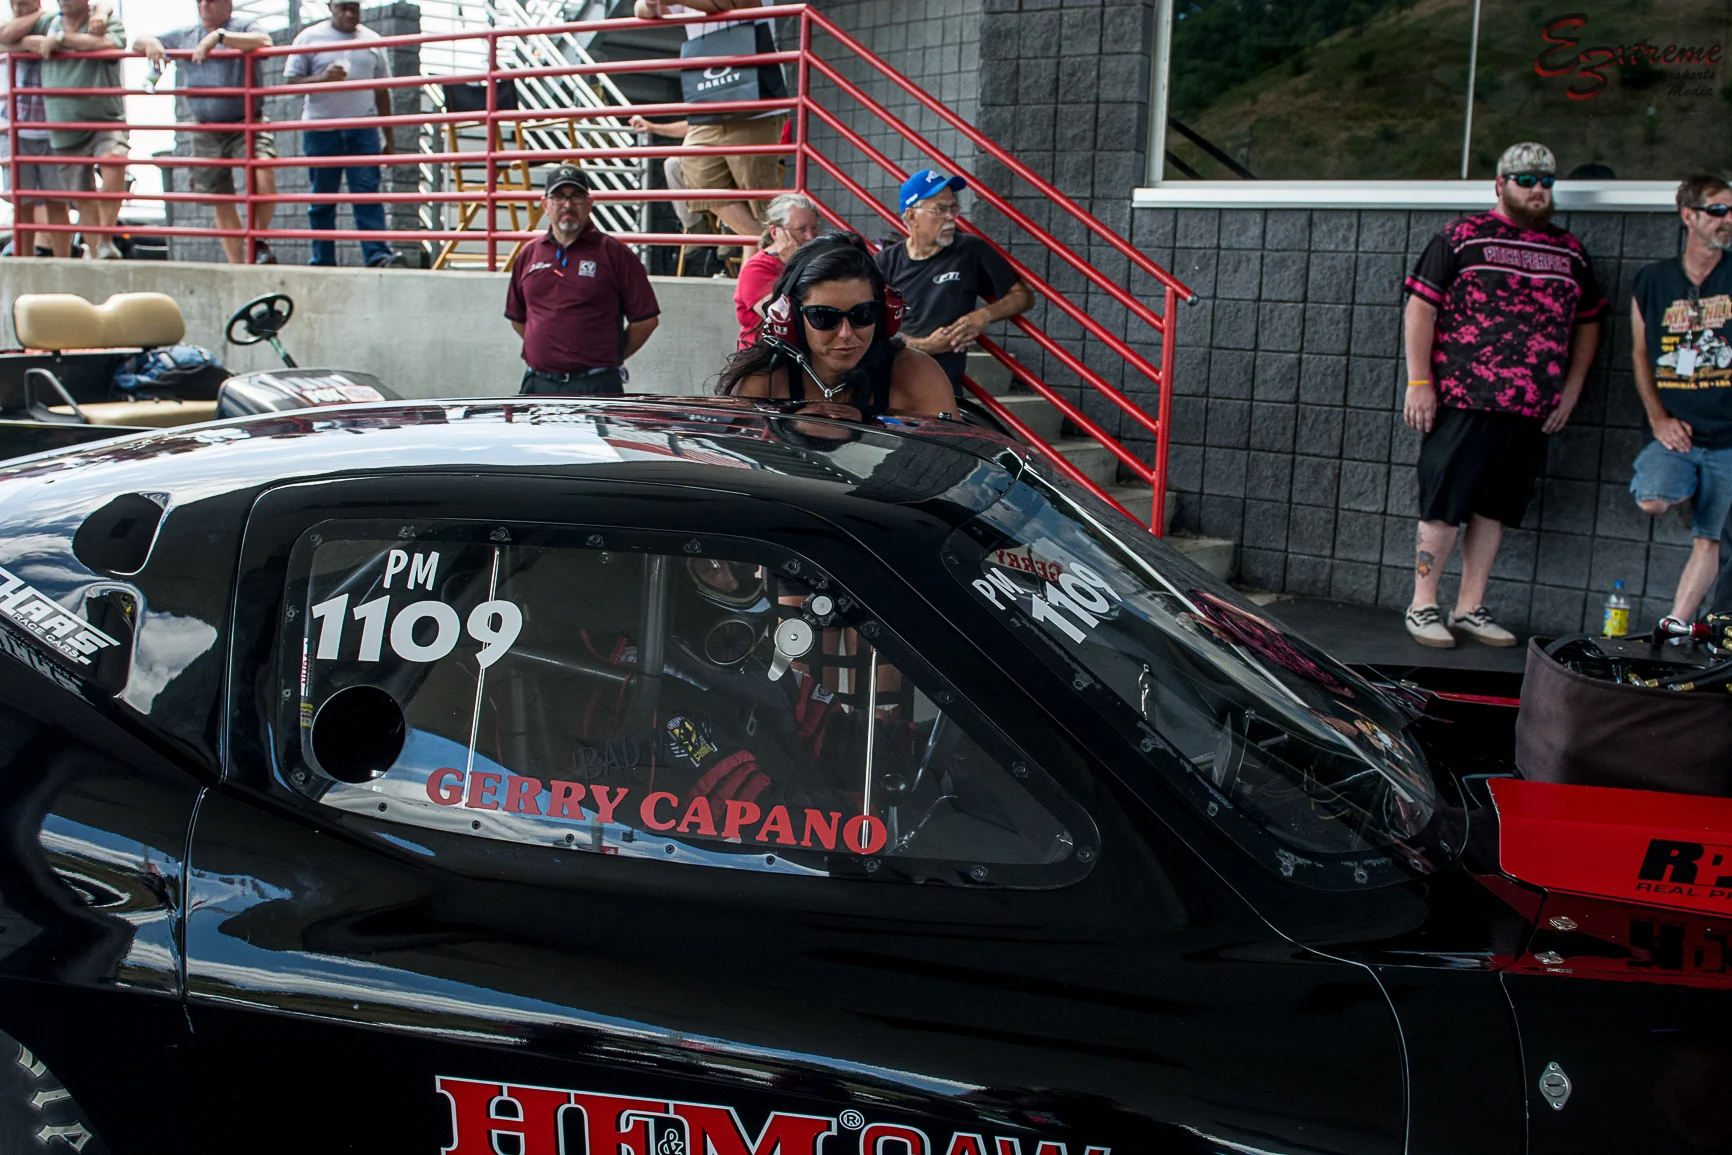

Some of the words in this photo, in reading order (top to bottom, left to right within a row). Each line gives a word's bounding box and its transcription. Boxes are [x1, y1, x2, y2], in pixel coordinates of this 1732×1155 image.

[697, 72, 740, 91] OAKLEY
[383, 549, 440, 591] PM
[972, 567, 1025, 611] PM
[1032, 562, 1123, 644] 1109
[12, 613, 45, 635] RACE
[45, 634, 80, 658] CARS
[312, 593, 523, 669] 1109
[572, 736, 641, 781] BAD
[426, 767, 629, 824] GERRY
[640, 791, 887, 855] CAPANO
[1636, 882, 1699, 897] REAL
